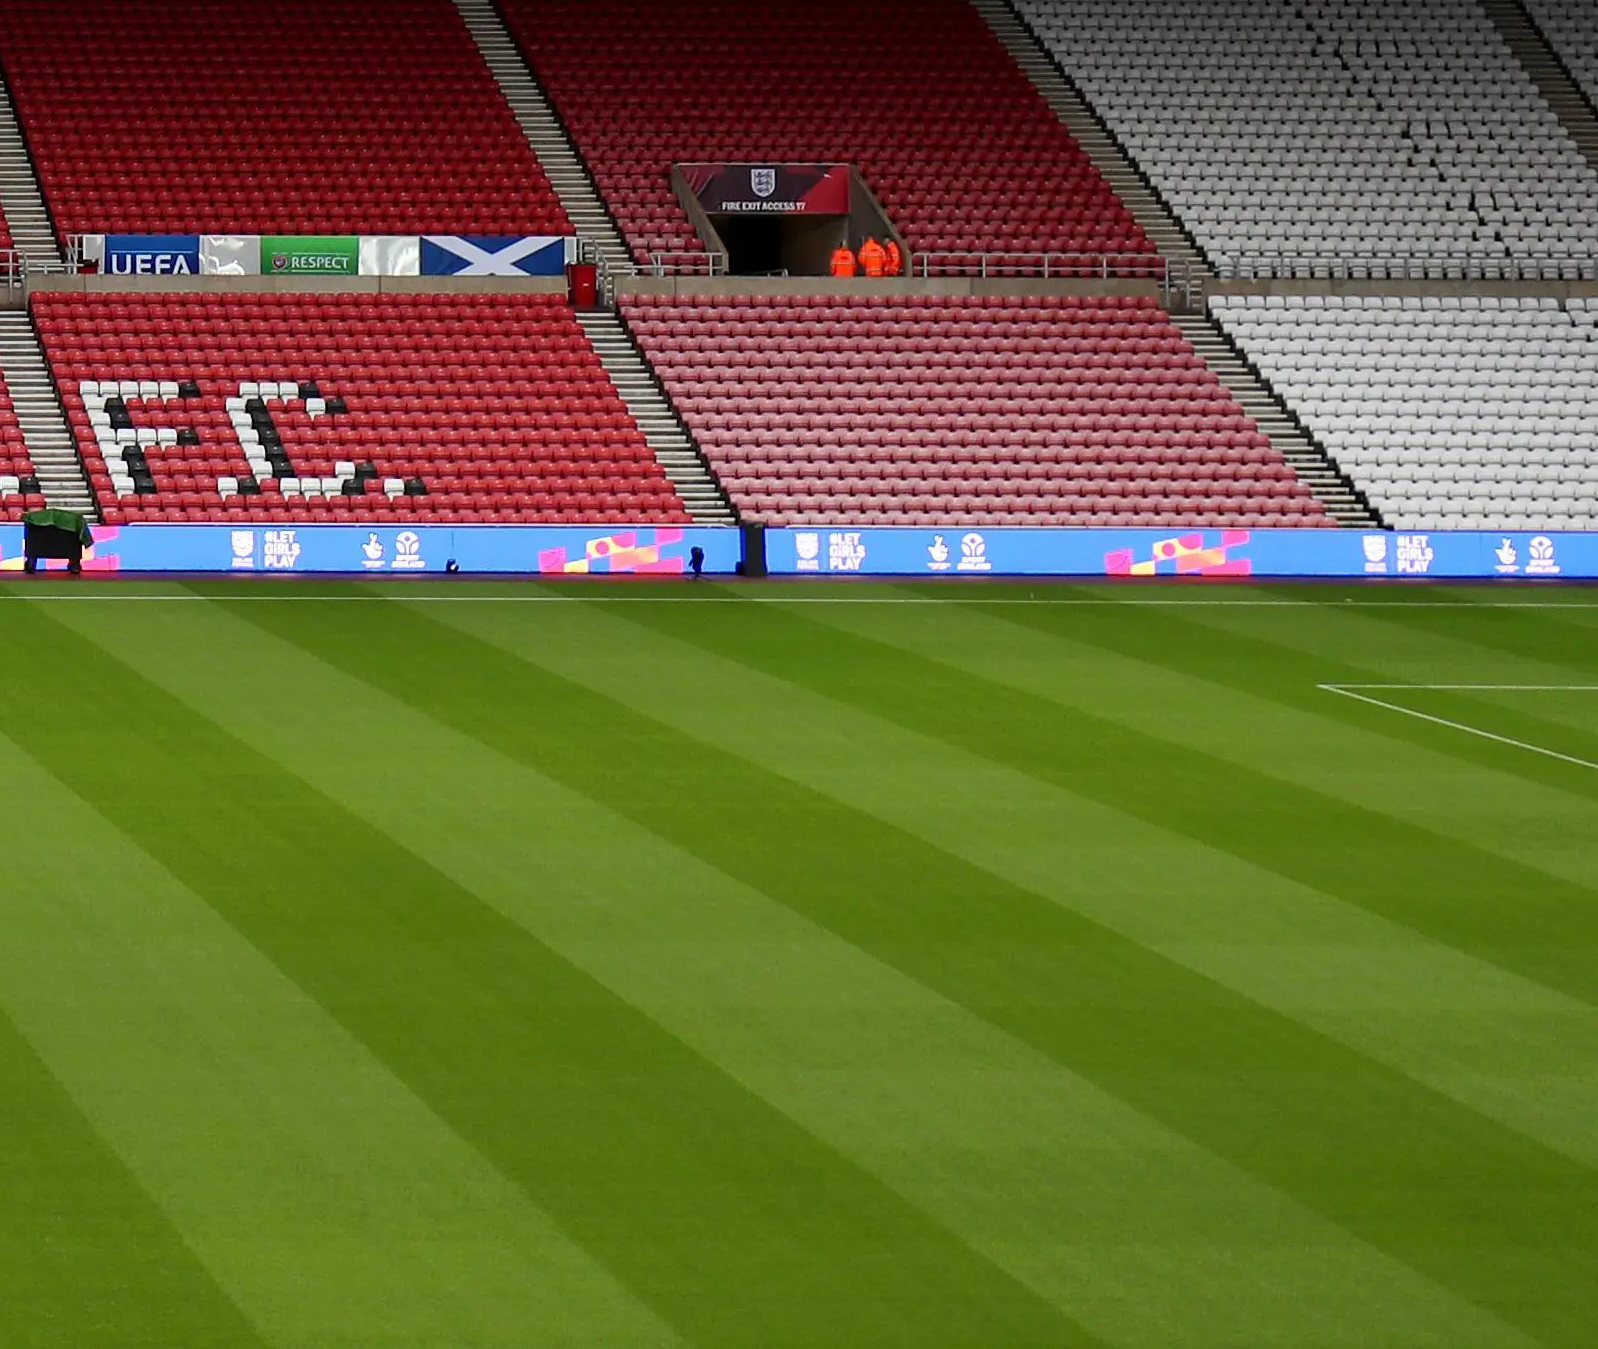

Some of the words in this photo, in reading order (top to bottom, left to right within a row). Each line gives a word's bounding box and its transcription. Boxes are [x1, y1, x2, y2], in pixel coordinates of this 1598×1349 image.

[722, 201, 741, 211] FIRE
[742, 201, 761, 211] EXIT
[761, 201, 795, 211] ACCESS
[111, 254, 193, 275] UEFA
[291, 255, 350, 269] RESPECT
[265, 555, 296, 567] PLAY
[829, 557, 861, 569] PLAY
[1397, 560, 1430, 572] PLAY
